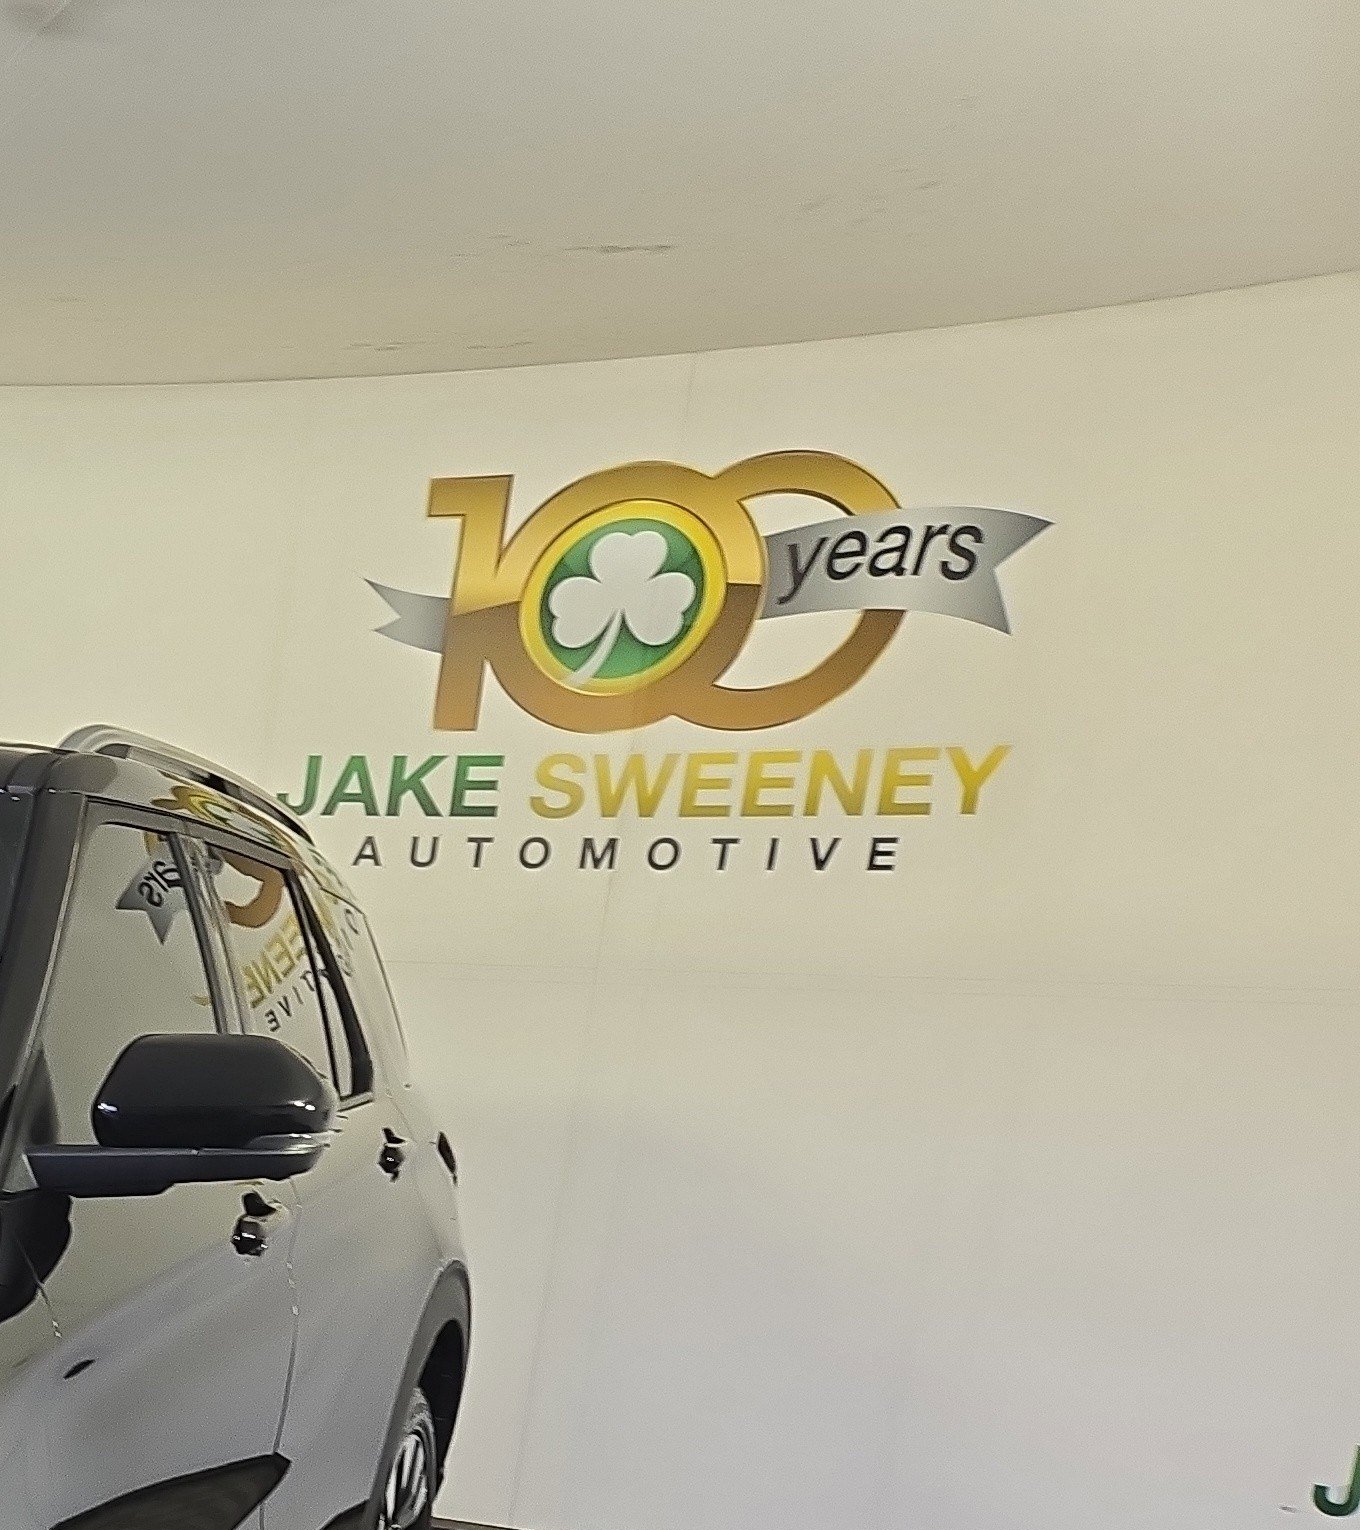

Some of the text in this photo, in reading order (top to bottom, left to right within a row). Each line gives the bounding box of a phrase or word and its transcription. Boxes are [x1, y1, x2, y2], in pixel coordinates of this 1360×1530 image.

[427, 449, 986, 732] 100 years
[277, 744, 1014, 819] JAKE SWEENEY
[352, 835, 900, 873] AUTOMOTIVE
